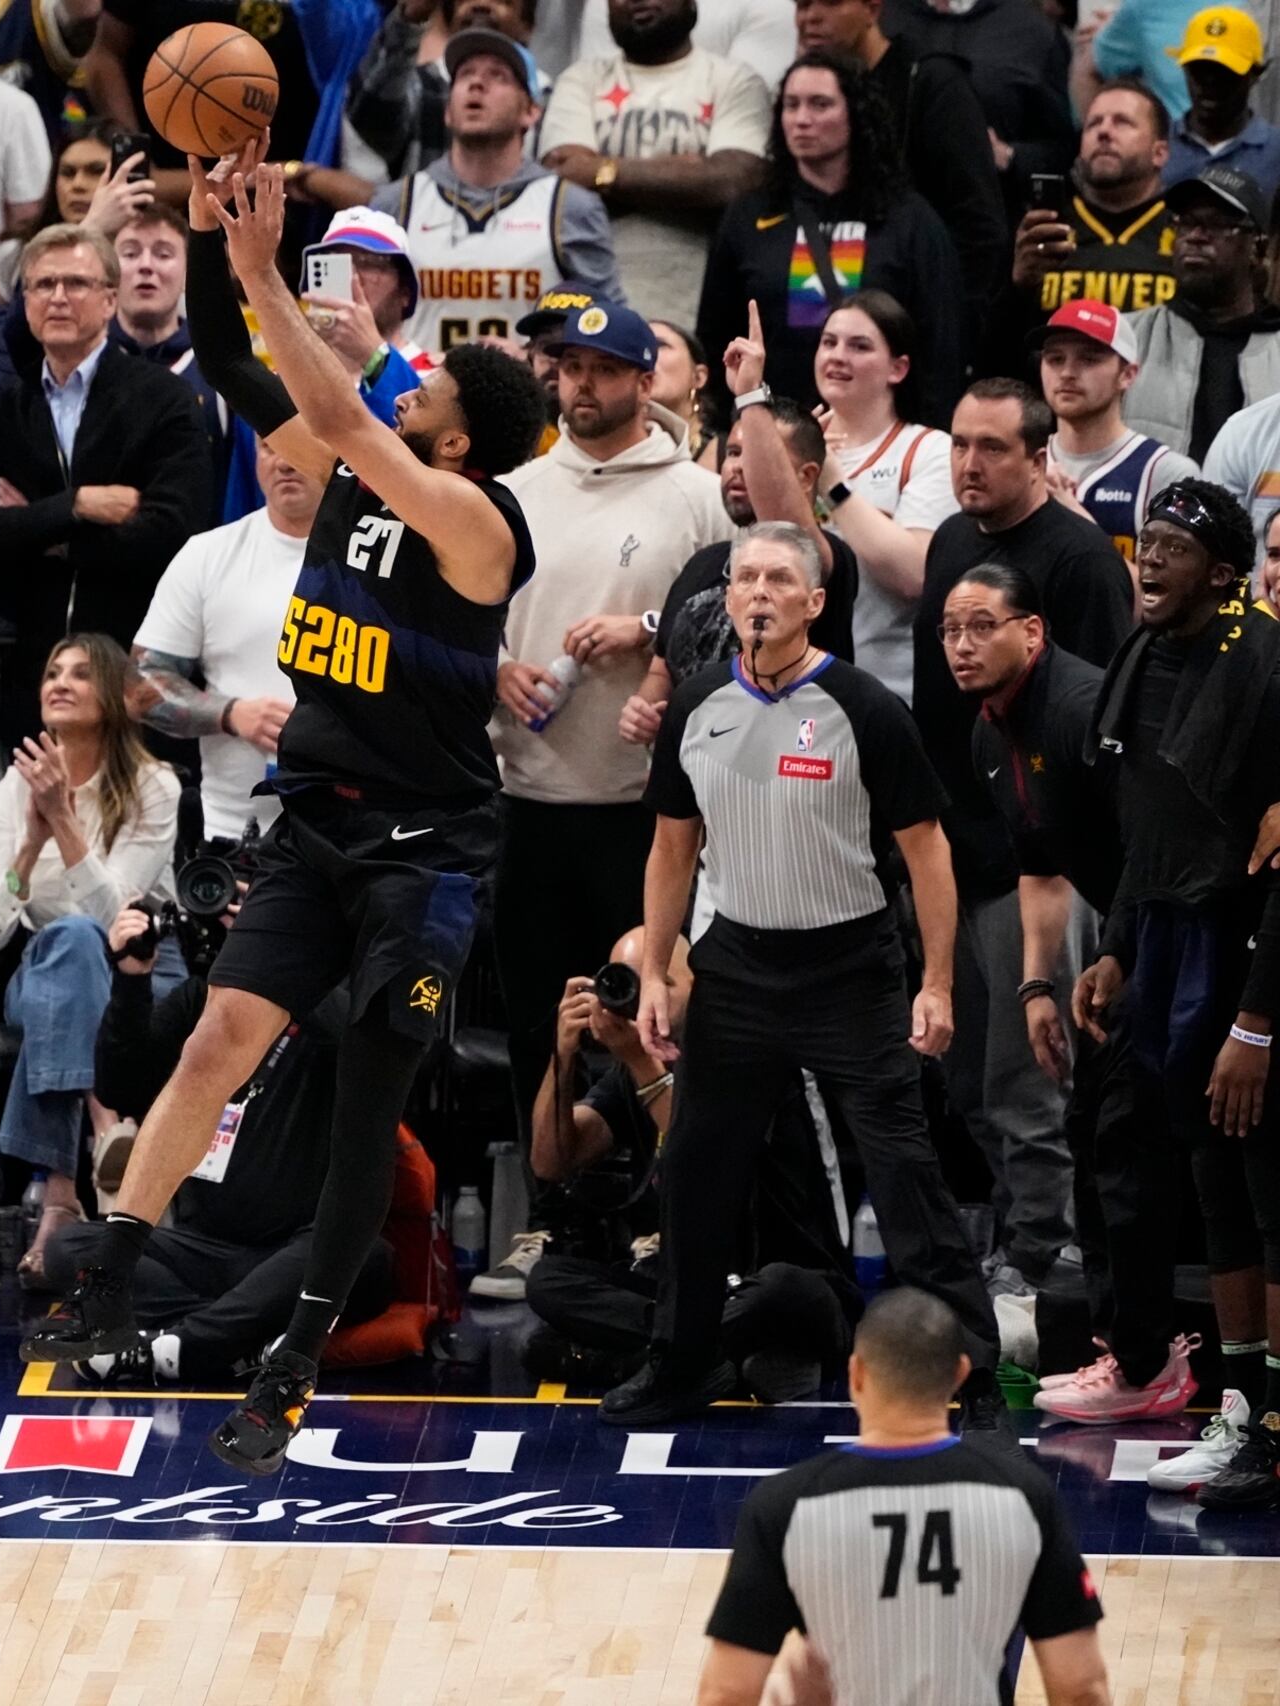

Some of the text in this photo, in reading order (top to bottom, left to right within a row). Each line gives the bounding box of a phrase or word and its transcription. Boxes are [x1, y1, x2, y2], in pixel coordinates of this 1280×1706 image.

[1040, 270, 1177, 312] DENVER
[346, 514, 405, 578] 27
[277, 595, 390, 693] 5280
[783, 760, 827, 775] Emirates
[872, 1509, 961, 1600] 74
